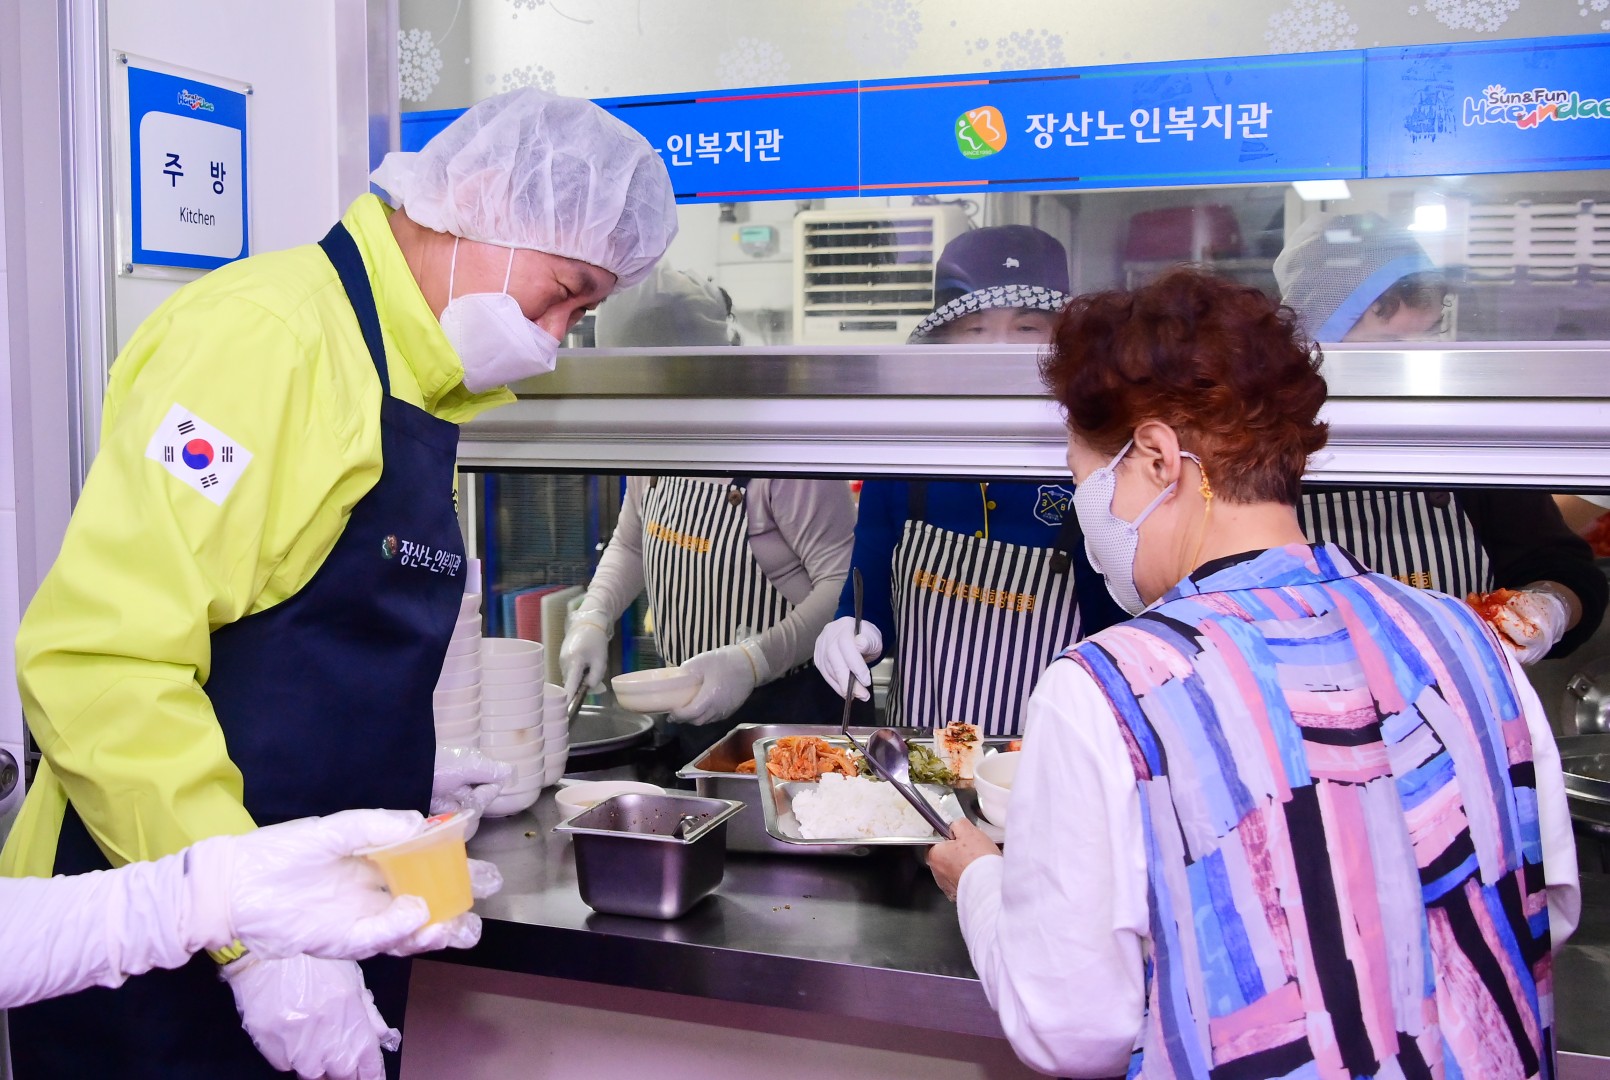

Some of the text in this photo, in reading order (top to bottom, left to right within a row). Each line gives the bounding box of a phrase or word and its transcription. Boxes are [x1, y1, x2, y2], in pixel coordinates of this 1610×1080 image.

[1489, 90, 1567, 105] Sun&Fun
[1025, 102, 1273, 149] 장산노인복지관
[653, 128, 784, 167] 인복지관
[179, 206, 215, 226] Kitchen
[400, 540, 461, 577] 장산노인복지관
